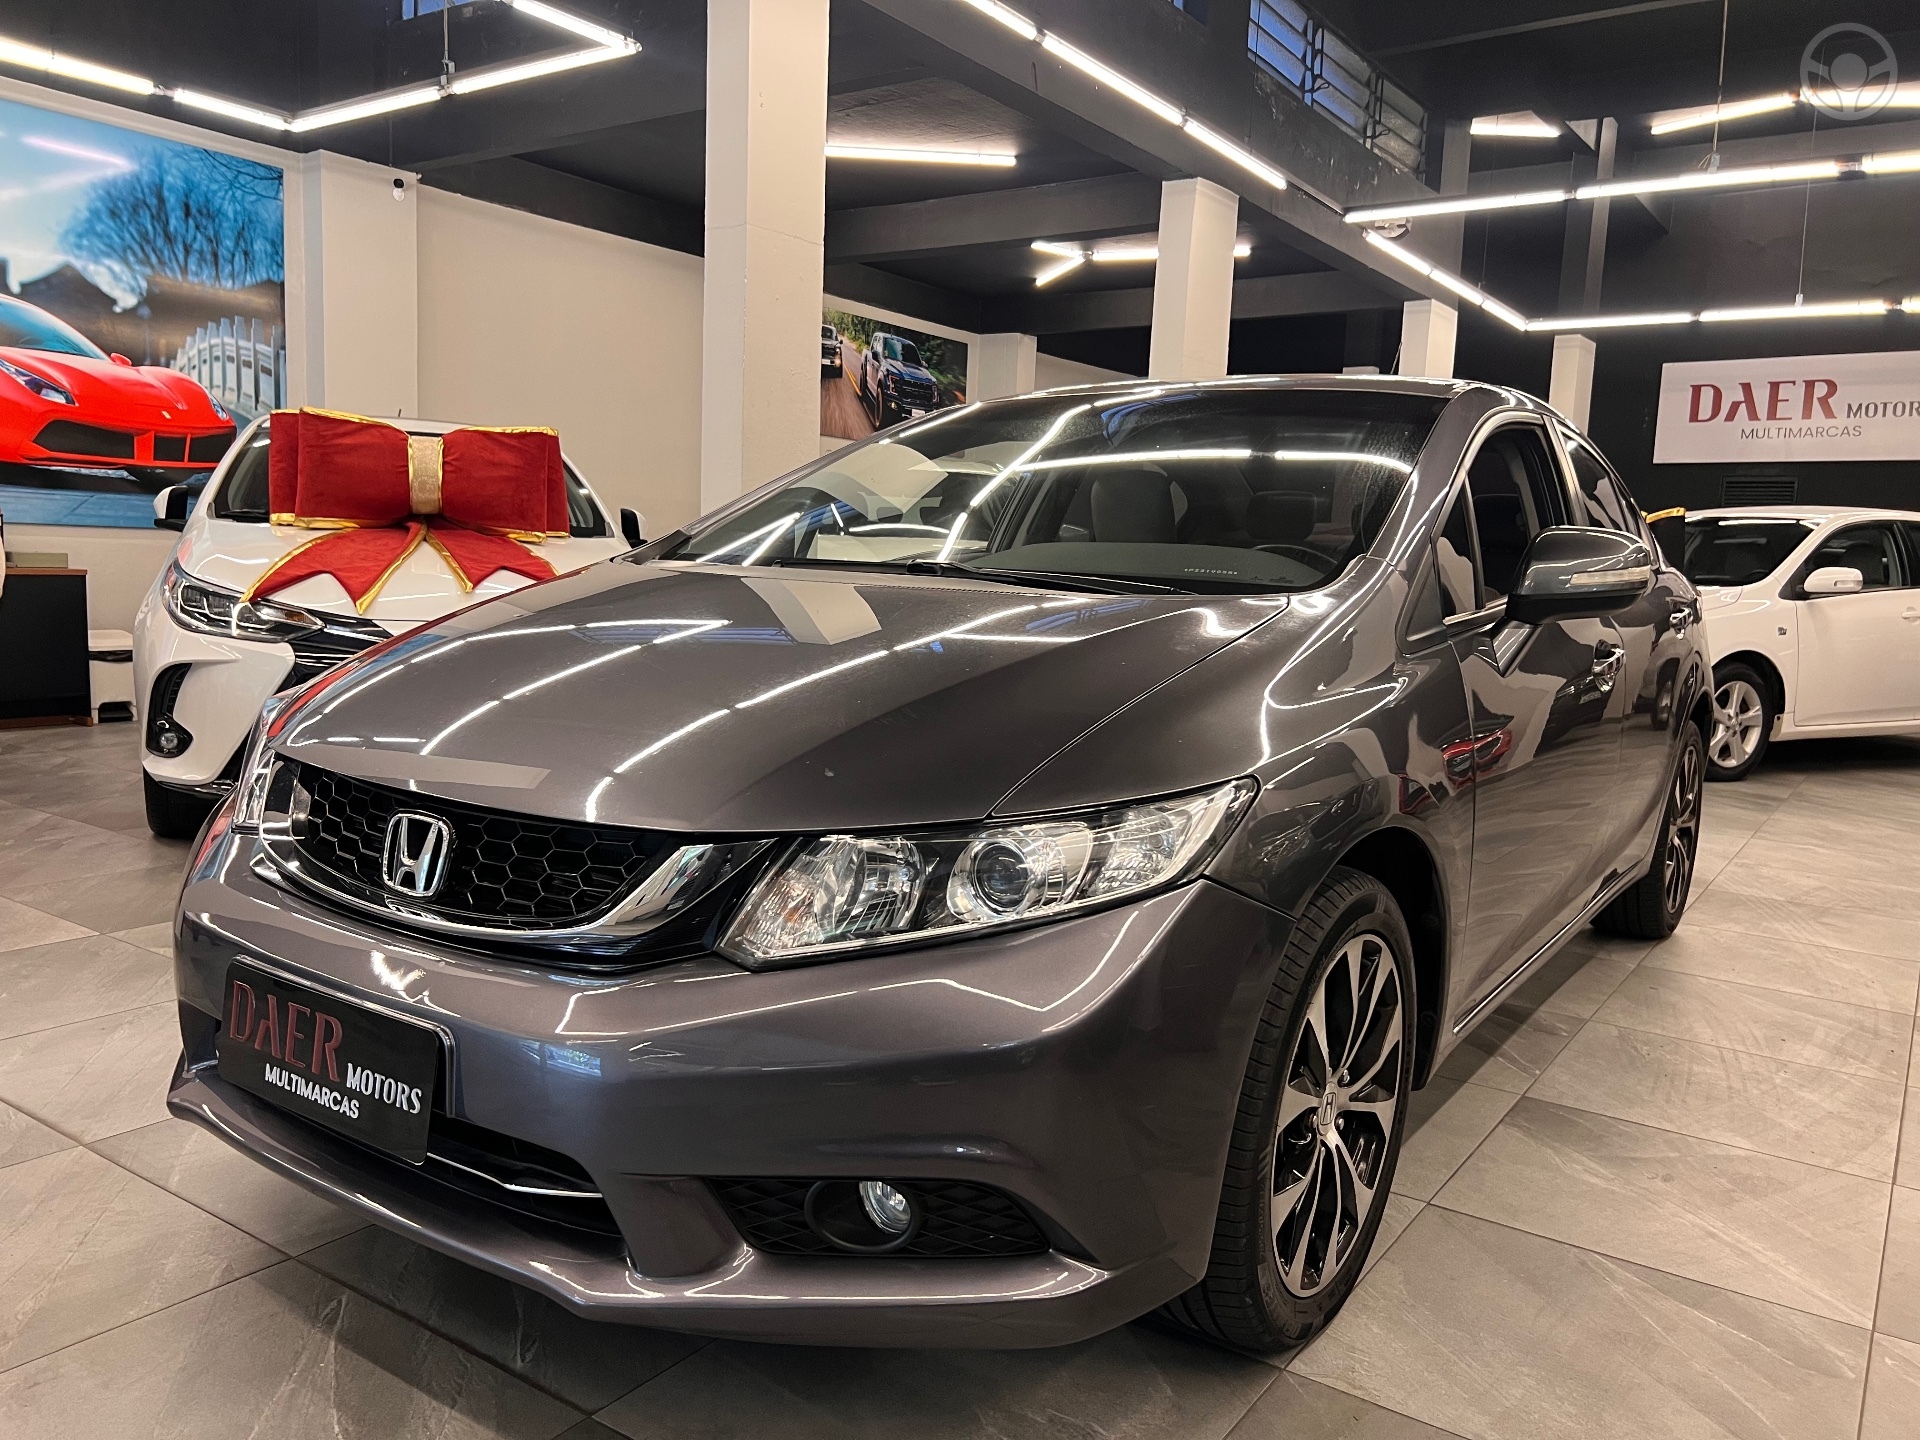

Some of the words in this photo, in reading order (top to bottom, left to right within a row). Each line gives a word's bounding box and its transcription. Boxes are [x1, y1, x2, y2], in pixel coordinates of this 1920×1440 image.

[1688, 379, 1838, 423] DAER
[1740, 425, 1863, 440] MULTIMARCAS
[229, 980, 343, 1082] DAER
[346, 1062, 422, 1114] MOTORS
[264, 1062, 360, 1119] MULTIMARCAS
